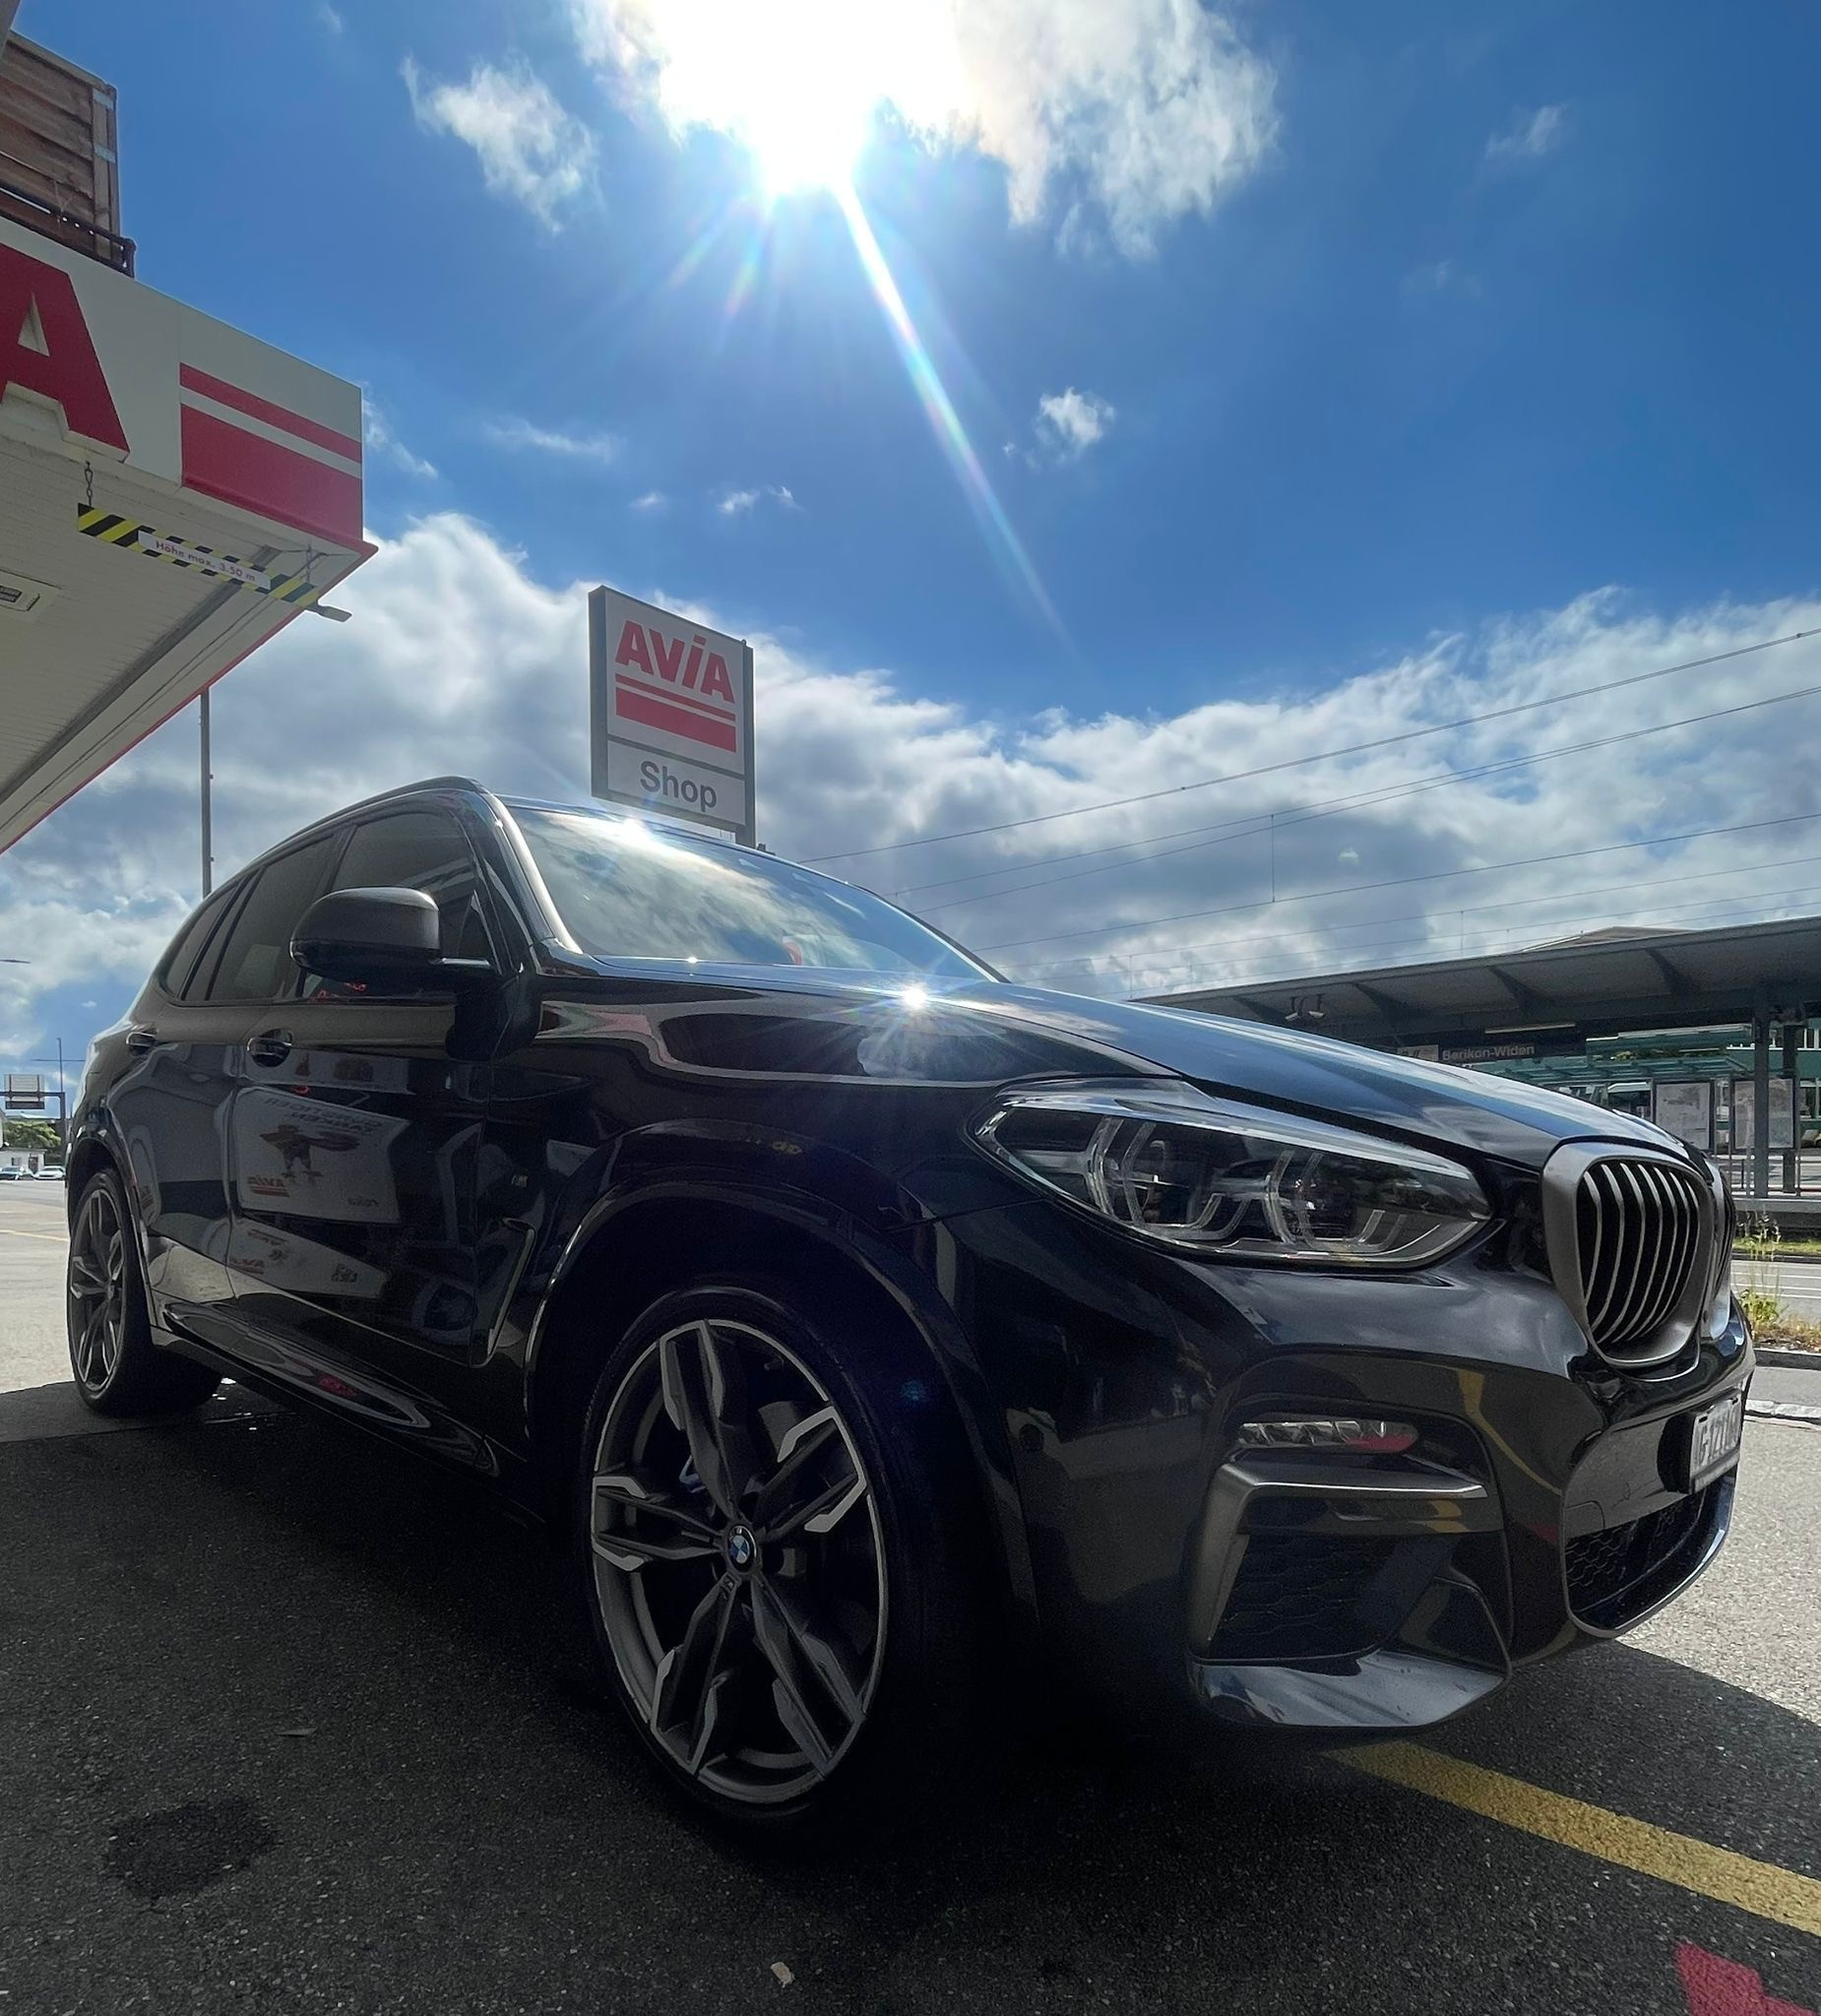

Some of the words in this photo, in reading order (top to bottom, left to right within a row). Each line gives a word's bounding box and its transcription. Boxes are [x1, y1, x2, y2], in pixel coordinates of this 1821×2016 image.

[156, 540, 185, 558] Höhe
[640, 760, 718, 813] Shop
[1442, 1045, 1536, 1061] Berikon-Widen
